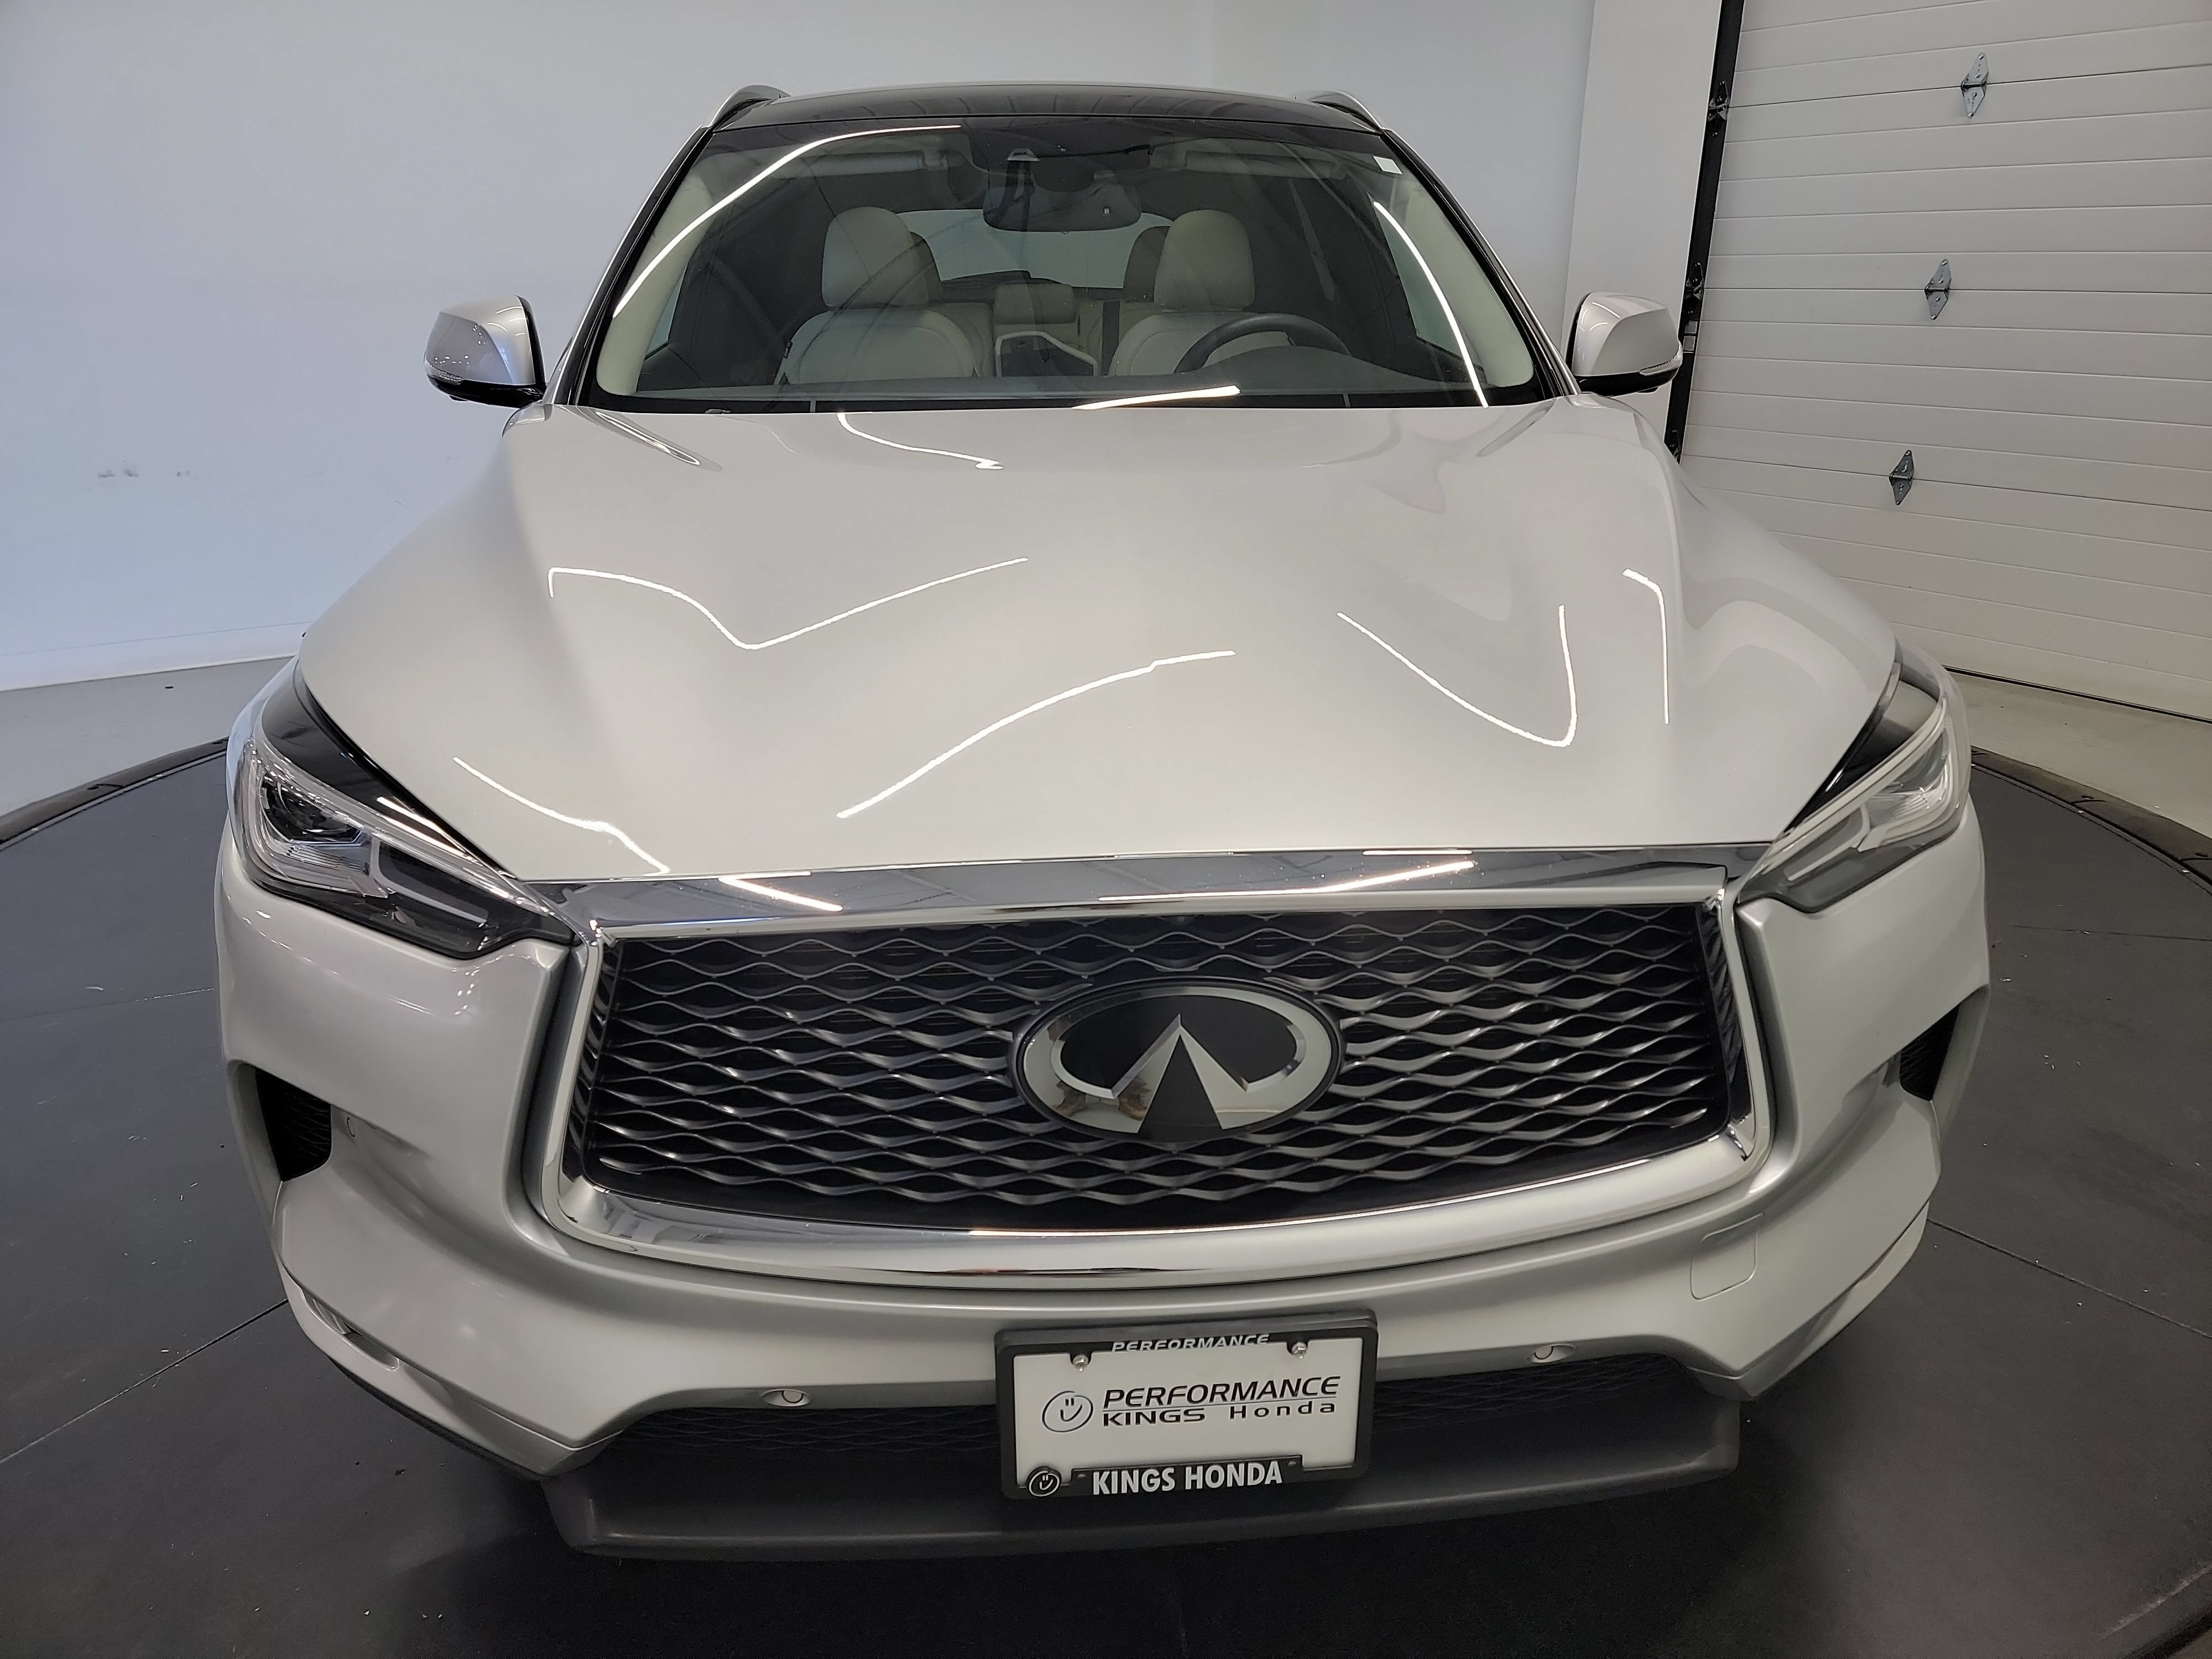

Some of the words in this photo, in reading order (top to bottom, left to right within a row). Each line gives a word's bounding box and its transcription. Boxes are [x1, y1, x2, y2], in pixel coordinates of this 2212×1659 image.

[1112, 1333, 1270, 1352] PERFORMANCE
[1103, 1376, 1341, 1408] PERFORMANCE
[1103, 1408, 1206, 1427] KINGS
[1230, 1401, 1335, 1420] Honda
[1093, 1467, 1176, 1495] KINGS
[1185, 1460, 1283, 1490] HONDA
